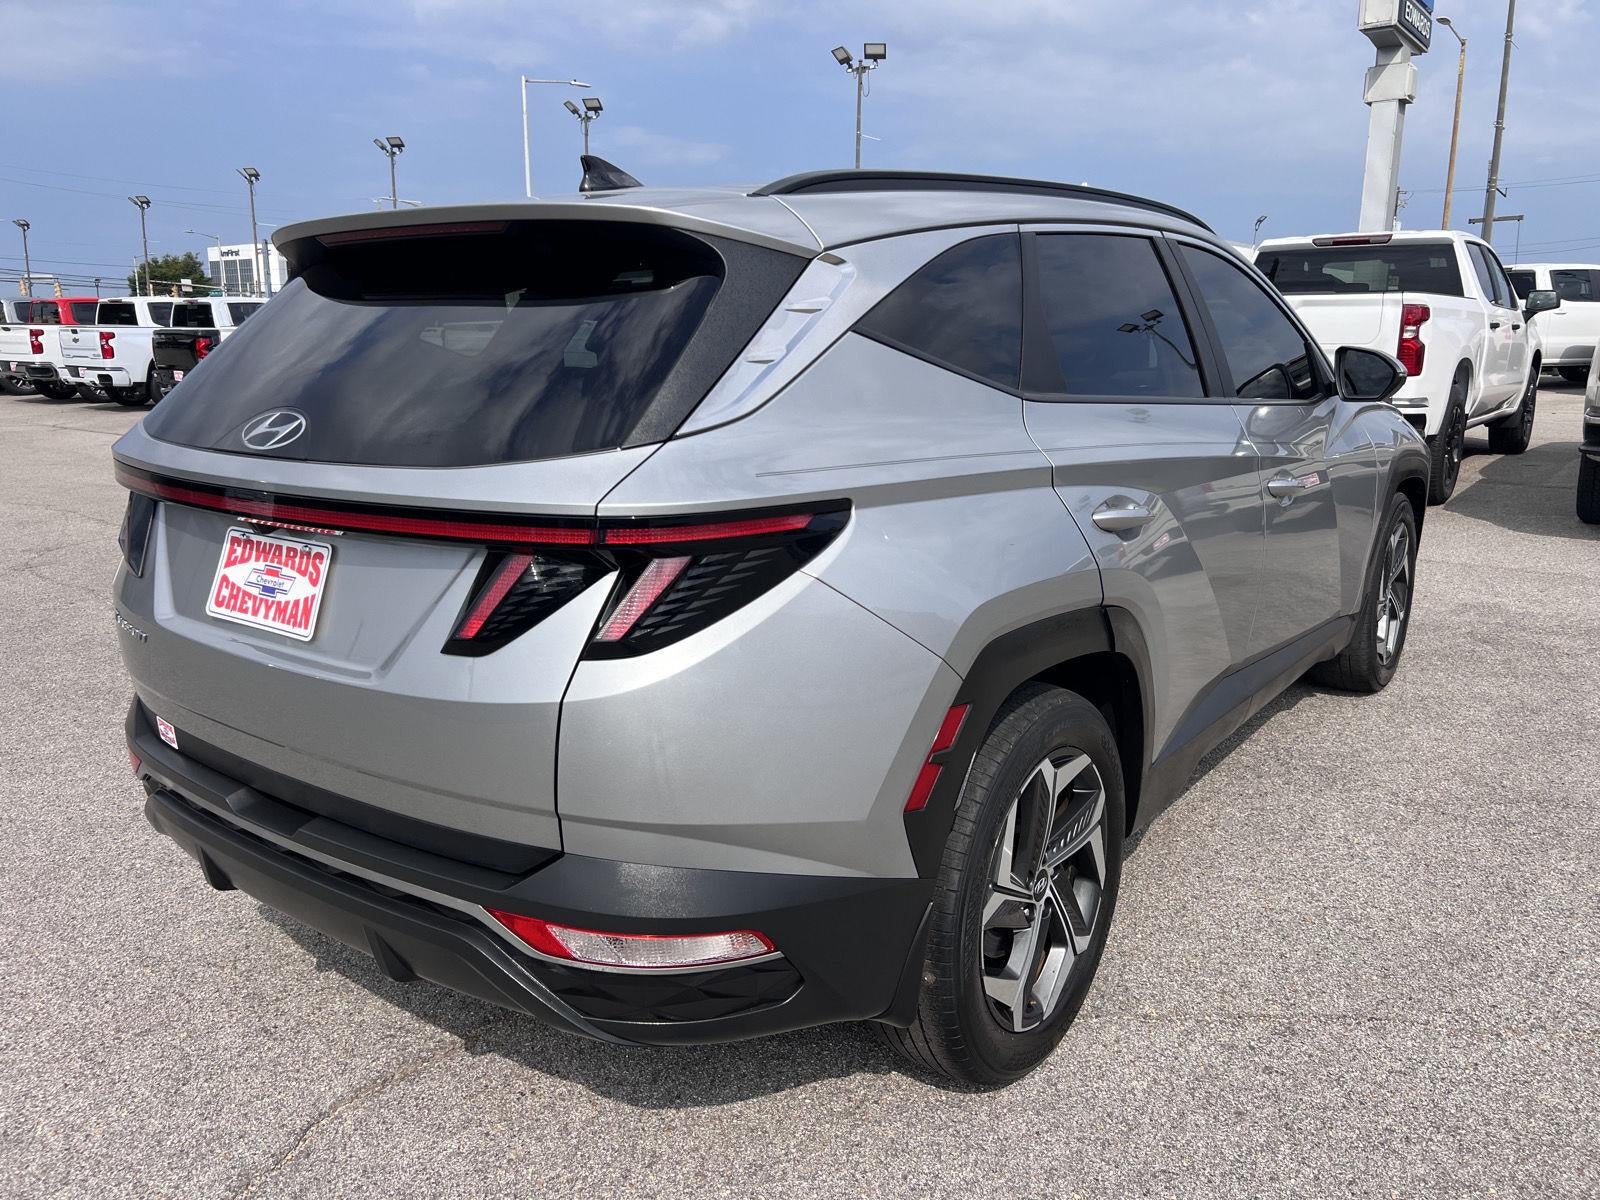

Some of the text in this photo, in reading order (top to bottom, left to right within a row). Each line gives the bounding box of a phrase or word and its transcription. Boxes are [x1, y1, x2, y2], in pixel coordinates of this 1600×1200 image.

[223, 535, 325, 588] EDWARDS
[256, 575, 285, 588] Chevrolet
[214, 573, 317, 630] CHEVYMAN
